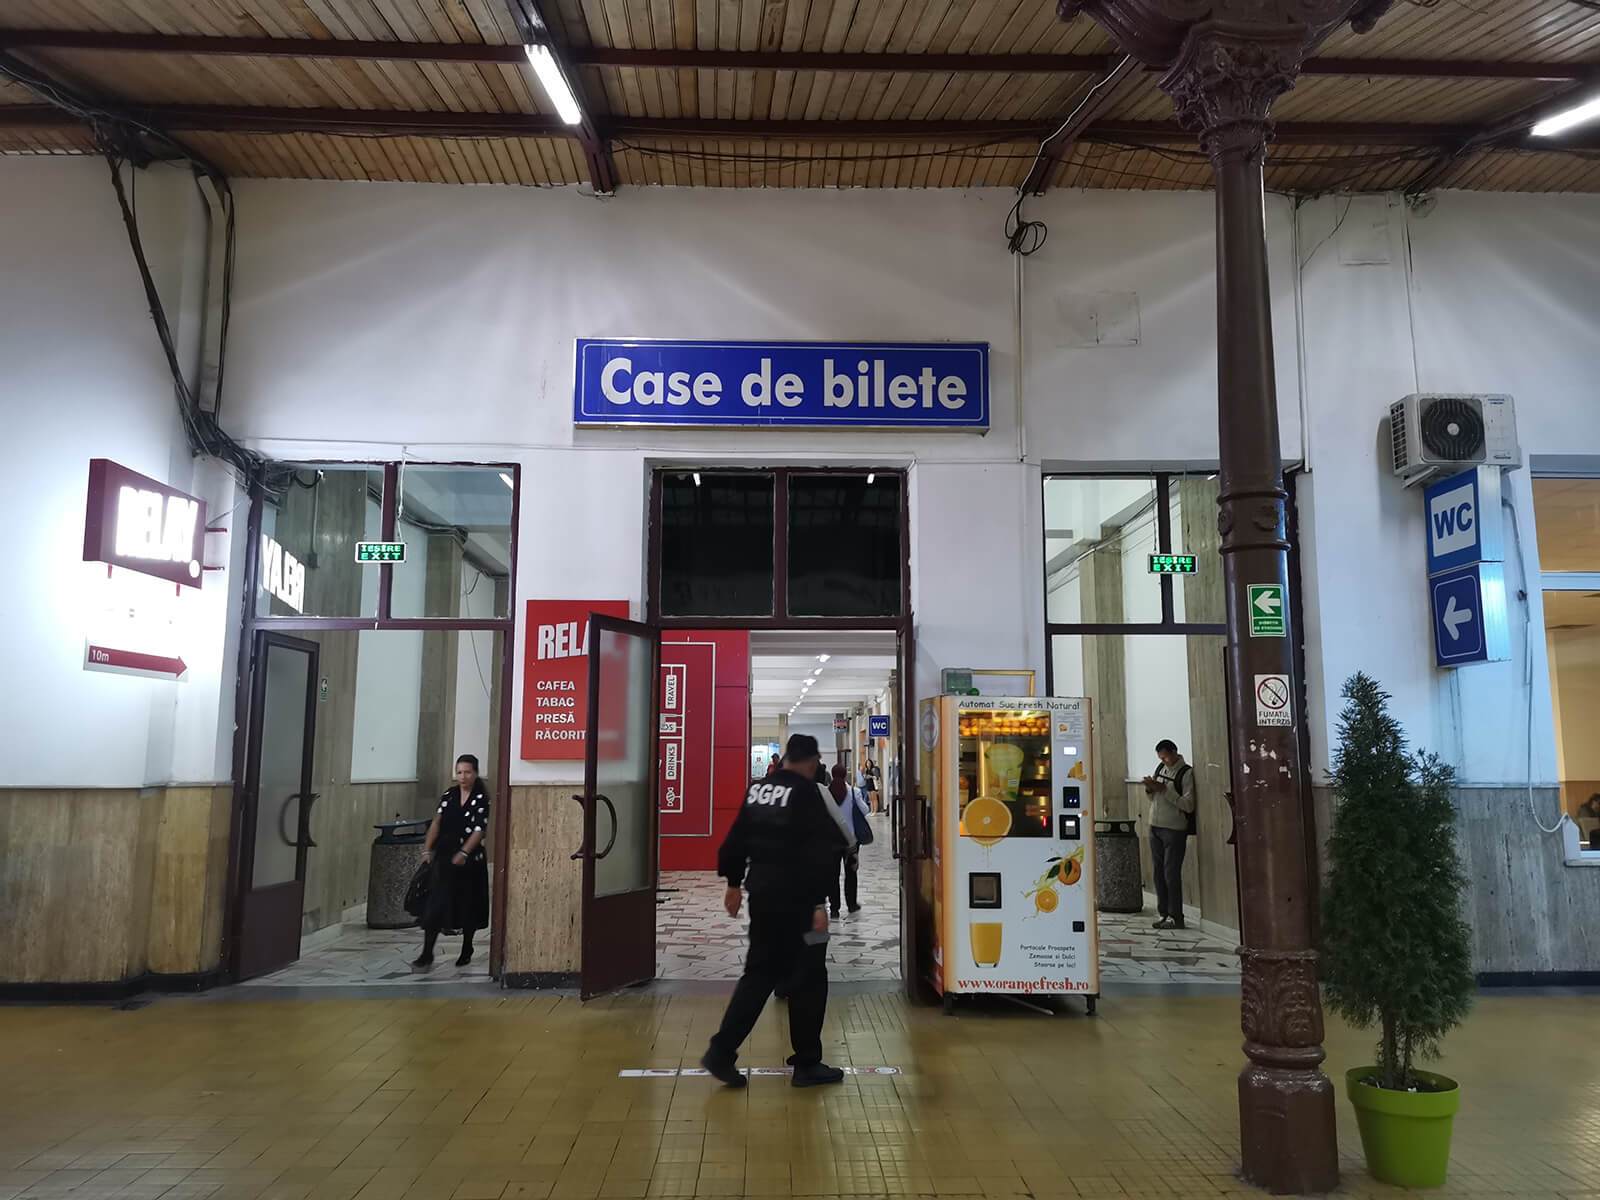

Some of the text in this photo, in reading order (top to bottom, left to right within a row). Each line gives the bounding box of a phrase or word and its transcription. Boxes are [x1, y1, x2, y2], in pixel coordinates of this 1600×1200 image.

[601, 357, 968, 410] Case de bilete
[1433, 502, 1473, 540] WC
[91, 649, 110, 663] 10m
[536, 680, 576, 691] CAFEA
[667, 676, 676, 706] TRAVEL
[536, 697, 575, 707] TABAC
[1018, 701, 1043, 709] Fresh
[1046, 701, 1080, 710] Natural
[535, 711, 576, 724] PRESĂ
[872, 722, 887, 730] WC
[667, 746, 676, 777] DRINKS
[748, 783, 792, 807] SGPI
[958, 975, 1089, 995] www.orangefresh.ro
